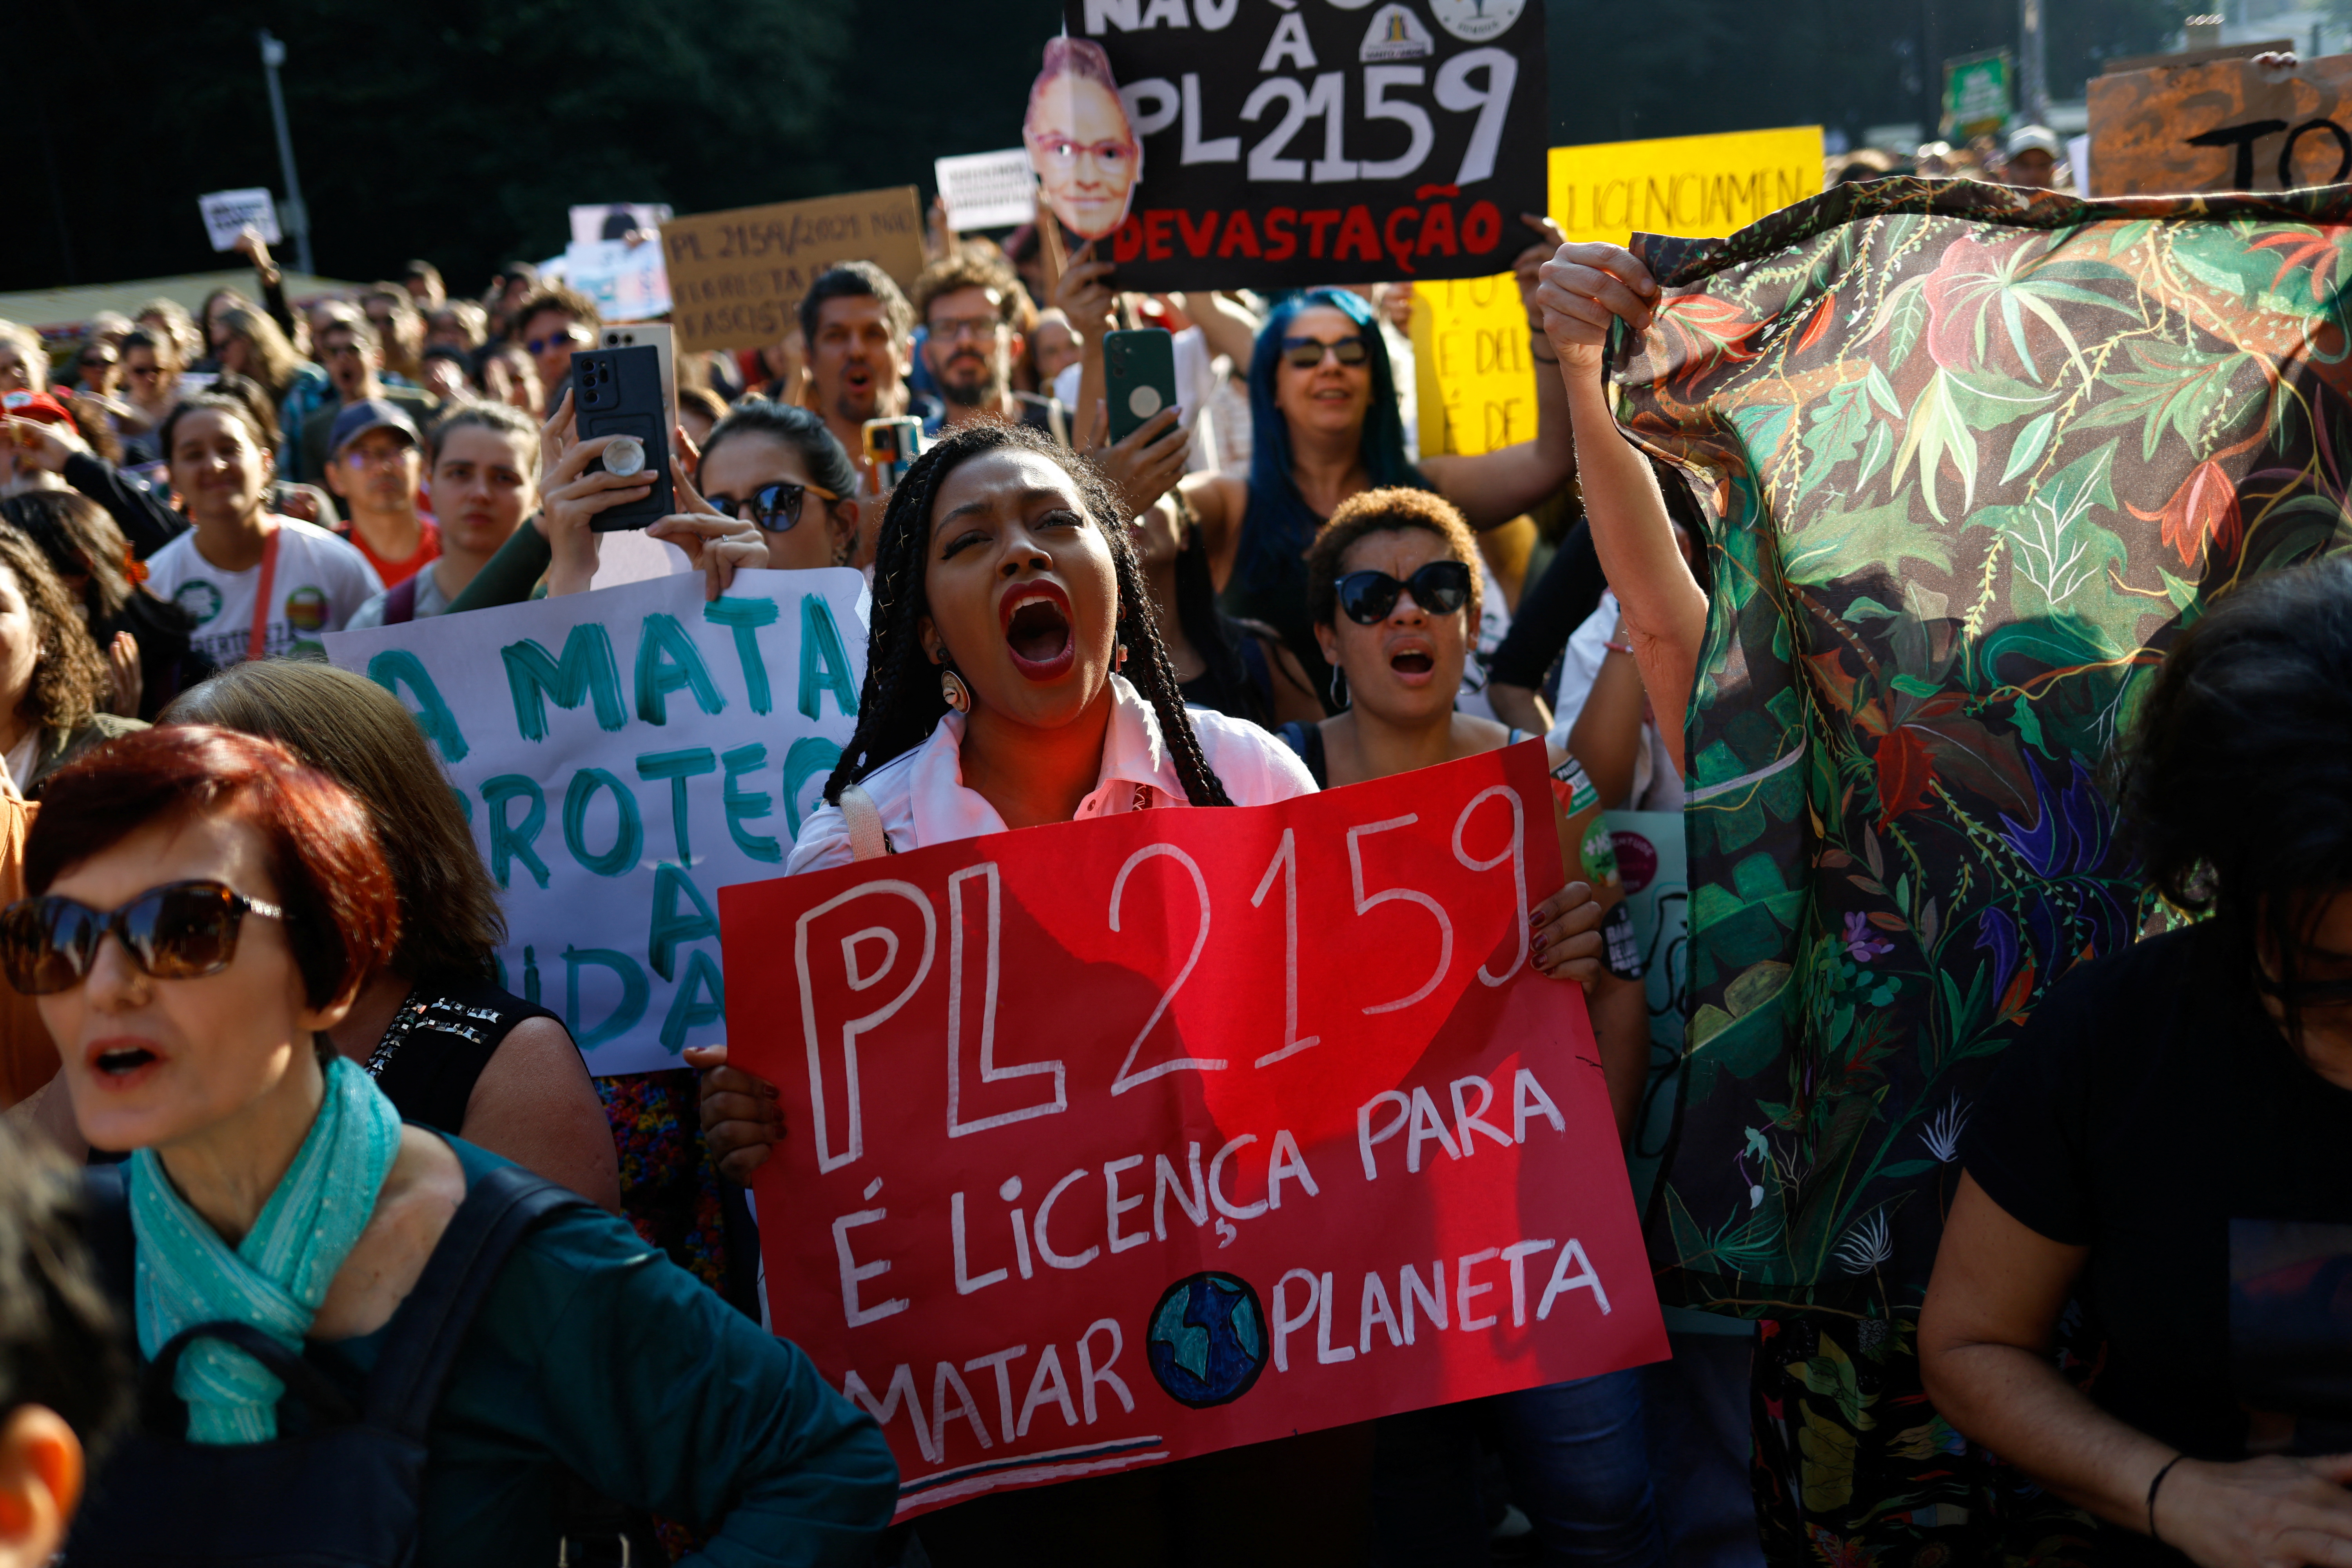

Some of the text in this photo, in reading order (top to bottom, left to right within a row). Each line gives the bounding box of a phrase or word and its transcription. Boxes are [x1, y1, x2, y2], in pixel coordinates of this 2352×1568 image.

[1239, 48, 1518, 187] 2159
[670, 233, 706, 263] PL
[1112, 183, 1503, 274] DEVASTAÇÃO
[367, 592, 861, 764] A MATA
[648, 861, 722, 983] A
[795, 861, 1067, 1174] PL
[1108, 785, 1531, 1096] 2159
[497, 944, 726, 1056] IDA
[831, 1176, 911, 1328] É
[1356, 1067, 1567, 1180] PARA
[842, 1238, 1612, 1464] MATAR PLANETA
